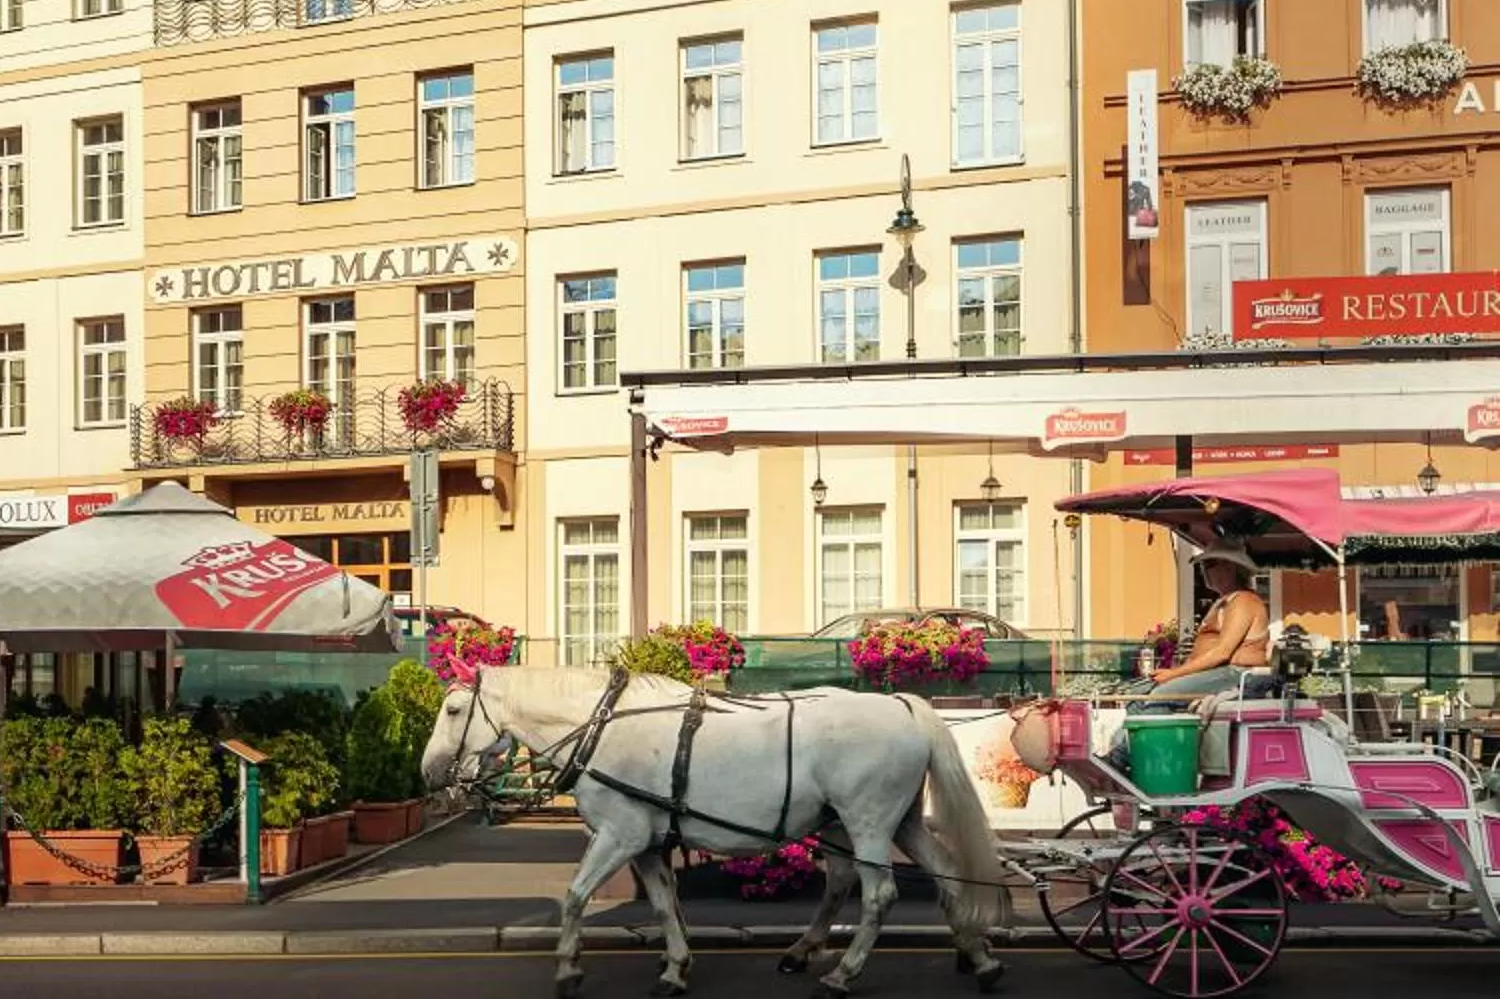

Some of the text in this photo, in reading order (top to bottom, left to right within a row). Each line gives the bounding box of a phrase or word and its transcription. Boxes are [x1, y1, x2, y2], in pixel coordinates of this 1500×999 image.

[181, 241, 476, 300] HOTEL MALTA
[255, 502, 405, 524] HOTEL MALTA
